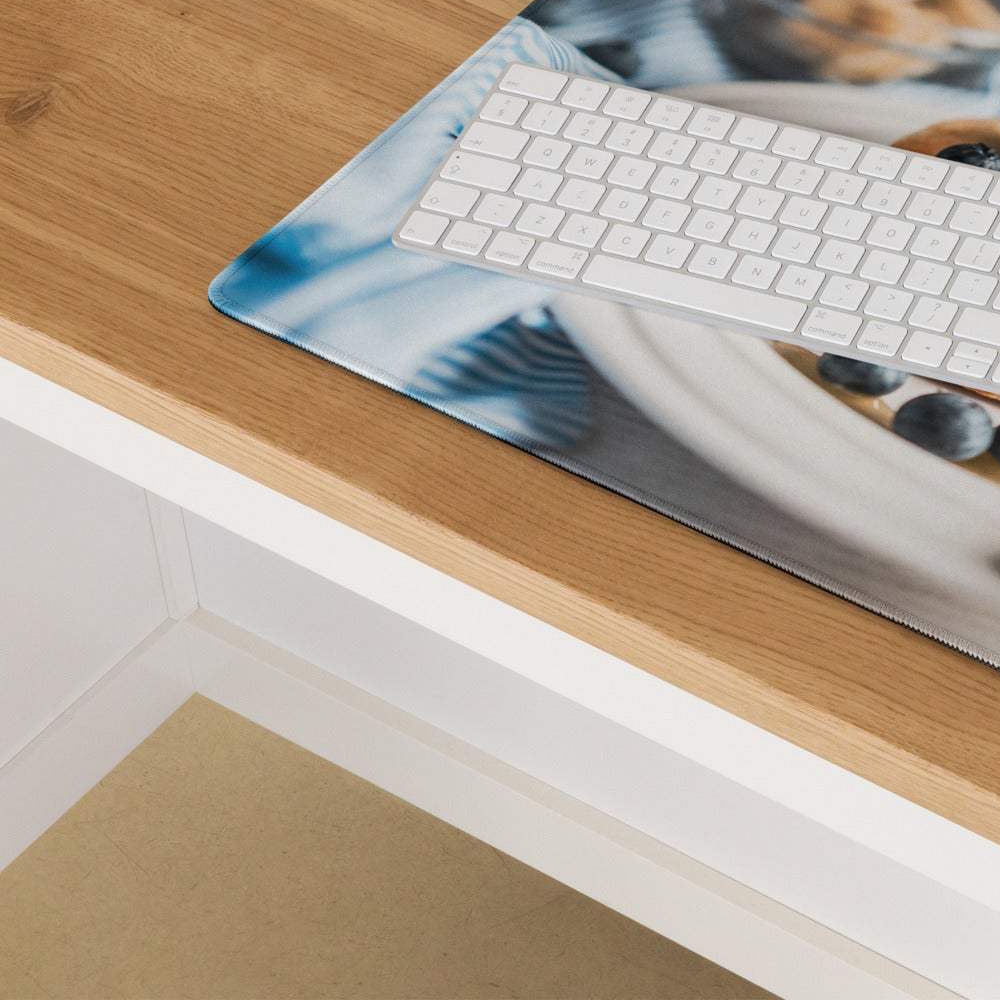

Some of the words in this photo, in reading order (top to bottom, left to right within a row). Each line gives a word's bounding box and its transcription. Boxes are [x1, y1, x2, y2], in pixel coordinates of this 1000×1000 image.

[542, 147, 554, 158] Q
[584, 157, 598, 168] W
[669, 177, 680, 188] R
[757, 197, 767, 207] Y
[798, 207, 811, 218] U
[885, 228, 897, 239] O
[929, 238, 941, 249] P
[534, 215, 547, 225] Z
[578, 225, 589, 235] X
[620, 235, 632, 246] C
[665, 245, 677, 256] V
[707, 255, 718, 267] B
[751, 266, 763, 277] N
[793, 277, 807, 288] M
